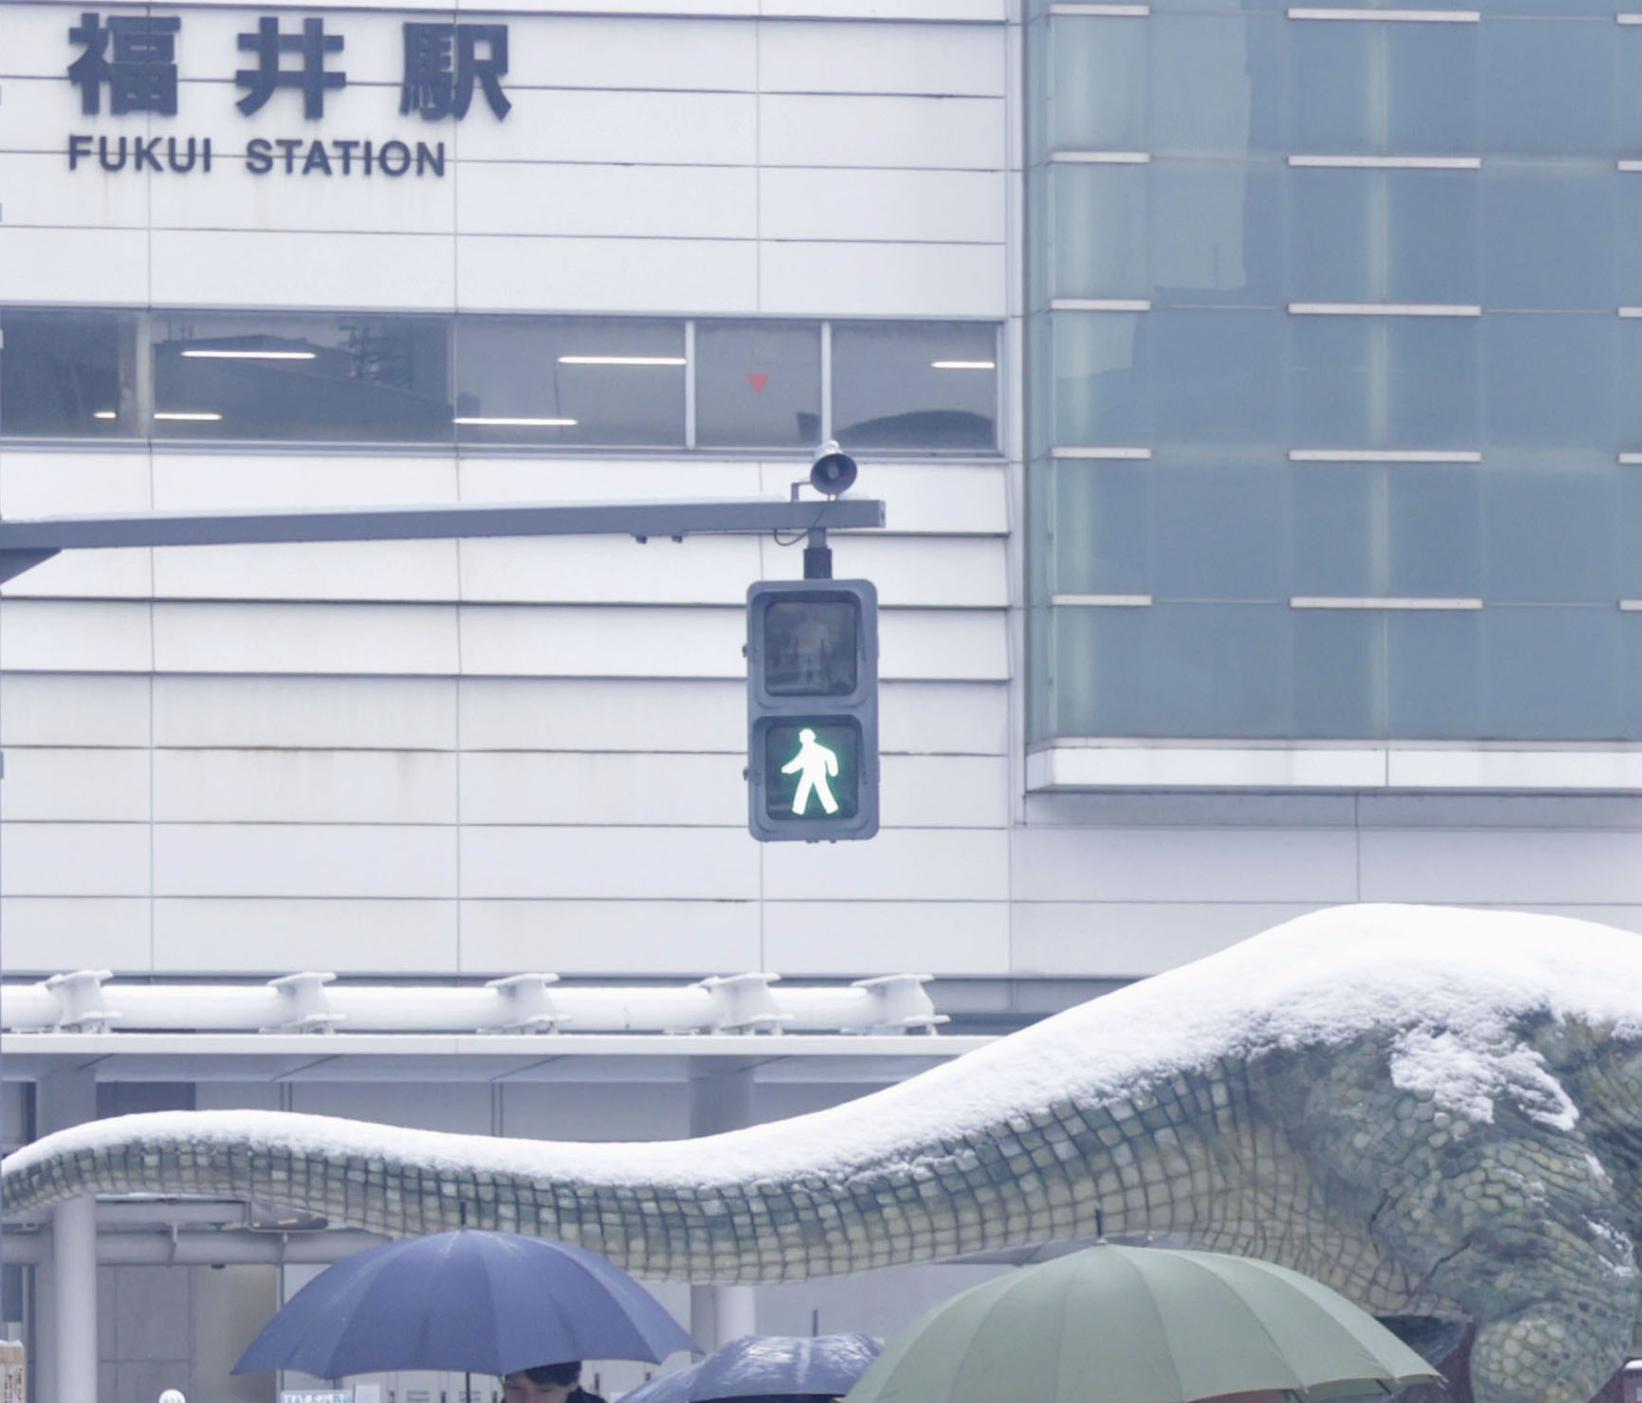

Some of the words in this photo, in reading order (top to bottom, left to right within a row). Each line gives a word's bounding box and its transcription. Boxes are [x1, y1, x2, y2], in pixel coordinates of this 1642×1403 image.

[67, 13, 512, 122] 福井駅
[68, 135, 212, 173] FUKUI
[245, 138, 446, 178] STATION
